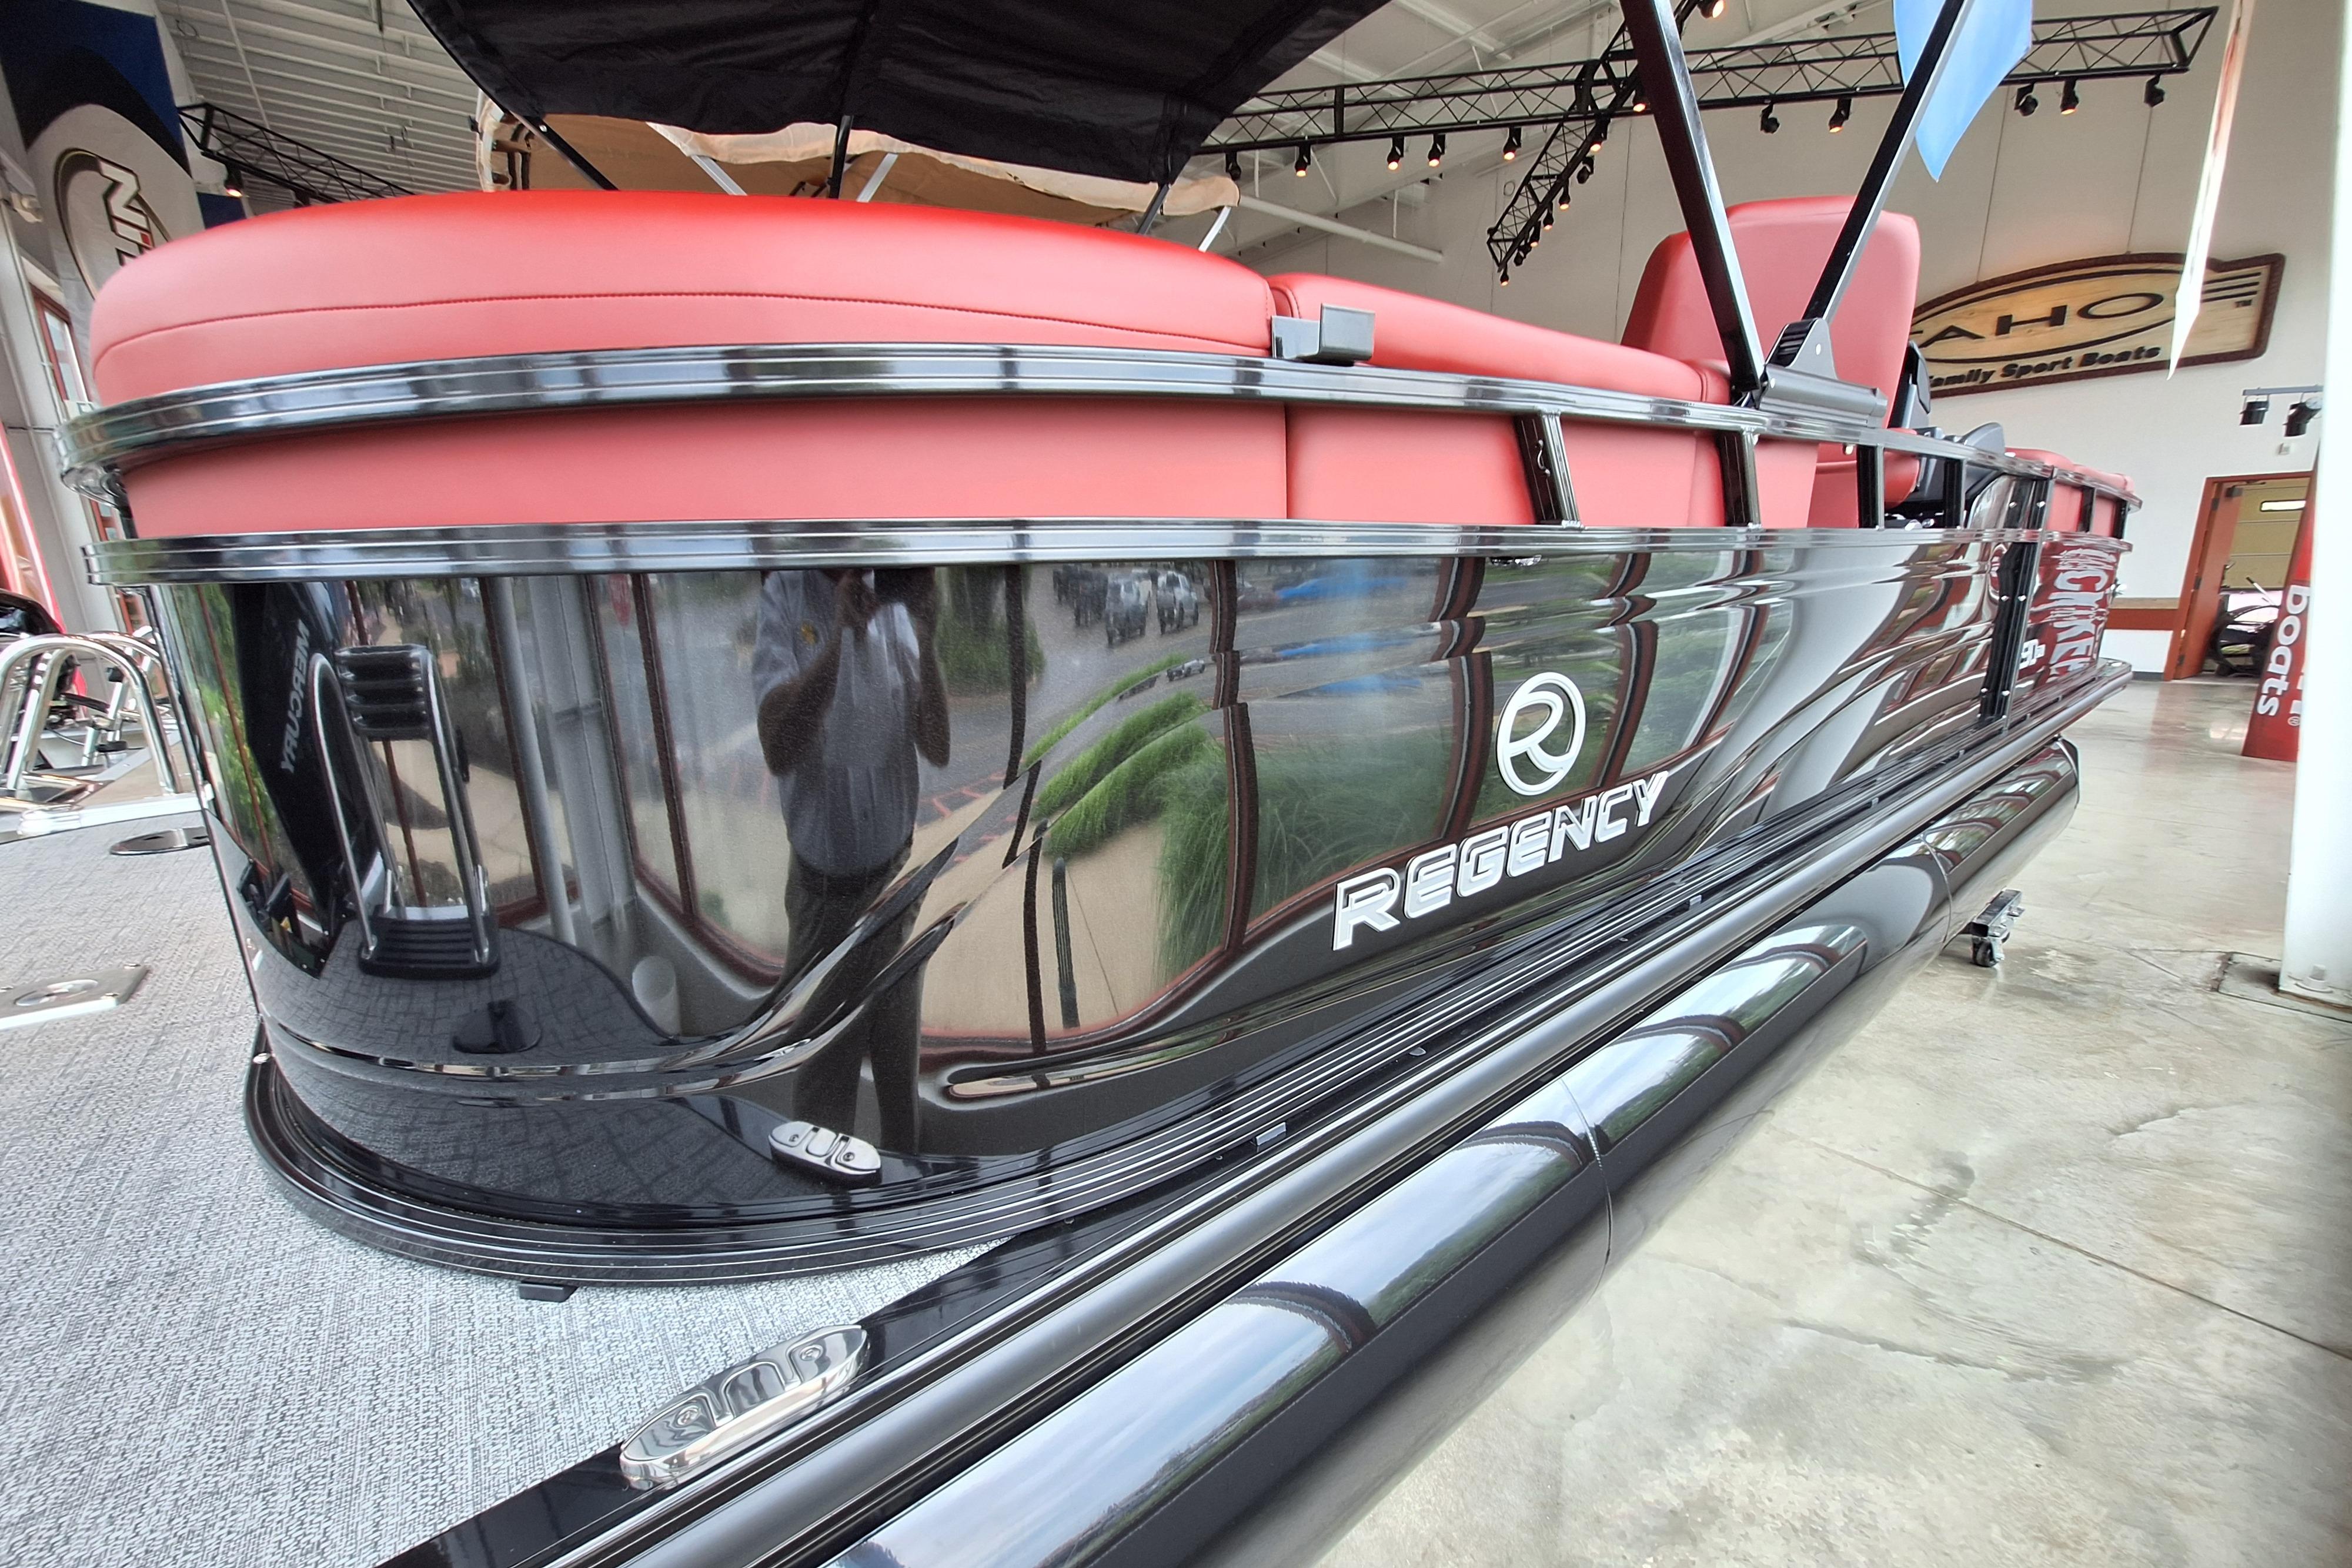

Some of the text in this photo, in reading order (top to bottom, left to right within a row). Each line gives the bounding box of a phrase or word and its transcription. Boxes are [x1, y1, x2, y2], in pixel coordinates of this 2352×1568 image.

[1909, 293, 2164, 348] AHO
[1929, 345, 2161, 387] amily Sport Boats
[2256, 584, 2311, 717] boats
[1332, 771, 1669, 951] REGENCY
